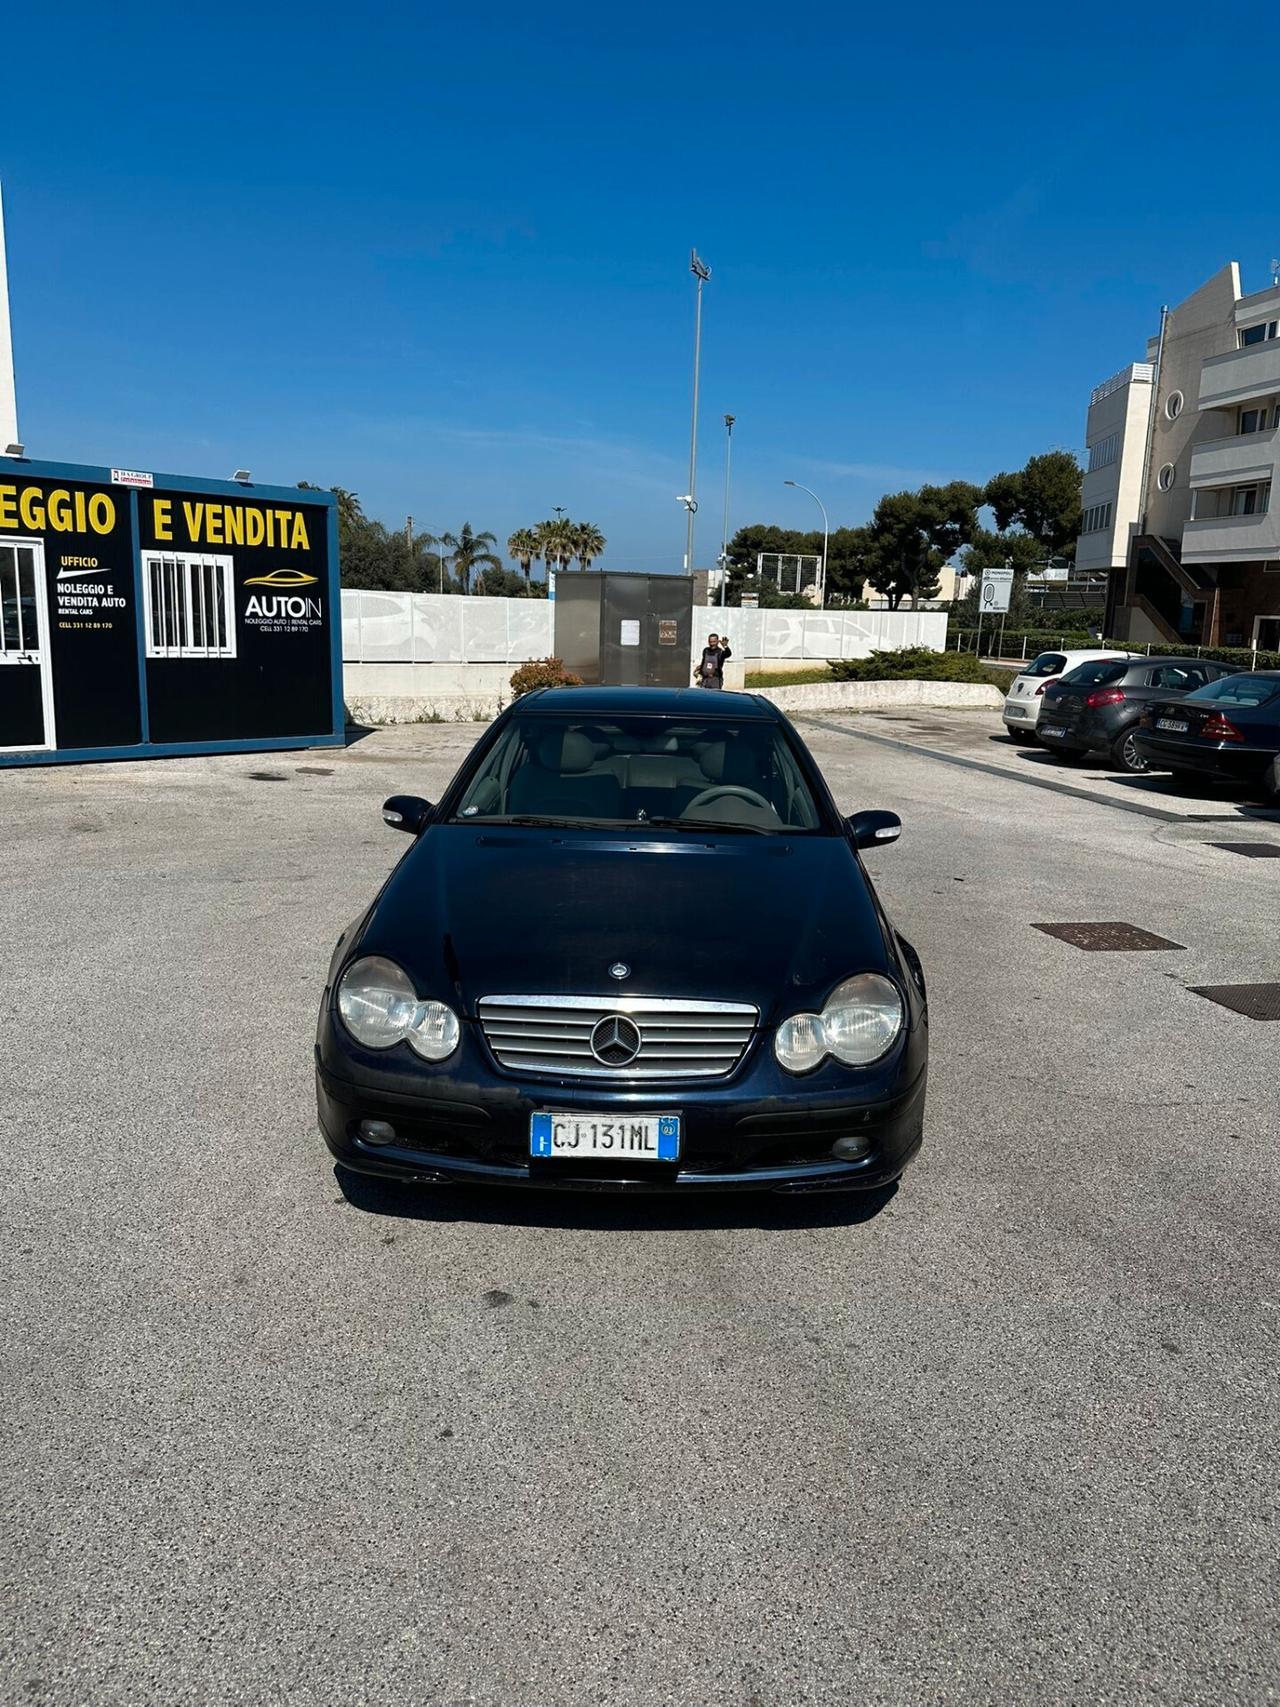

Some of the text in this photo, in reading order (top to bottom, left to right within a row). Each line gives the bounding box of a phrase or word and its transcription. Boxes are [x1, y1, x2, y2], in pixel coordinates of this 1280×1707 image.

[0, 484, 311, 551] EGGIO E VENDITA
[60, 555, 98, 568] UFFICIO
[57, 583, 114, 595] NOLEGGIO E
[57, 596, 127, 608] VENDITA AUTO
[244, 595, 322, 618] AUTOIN
